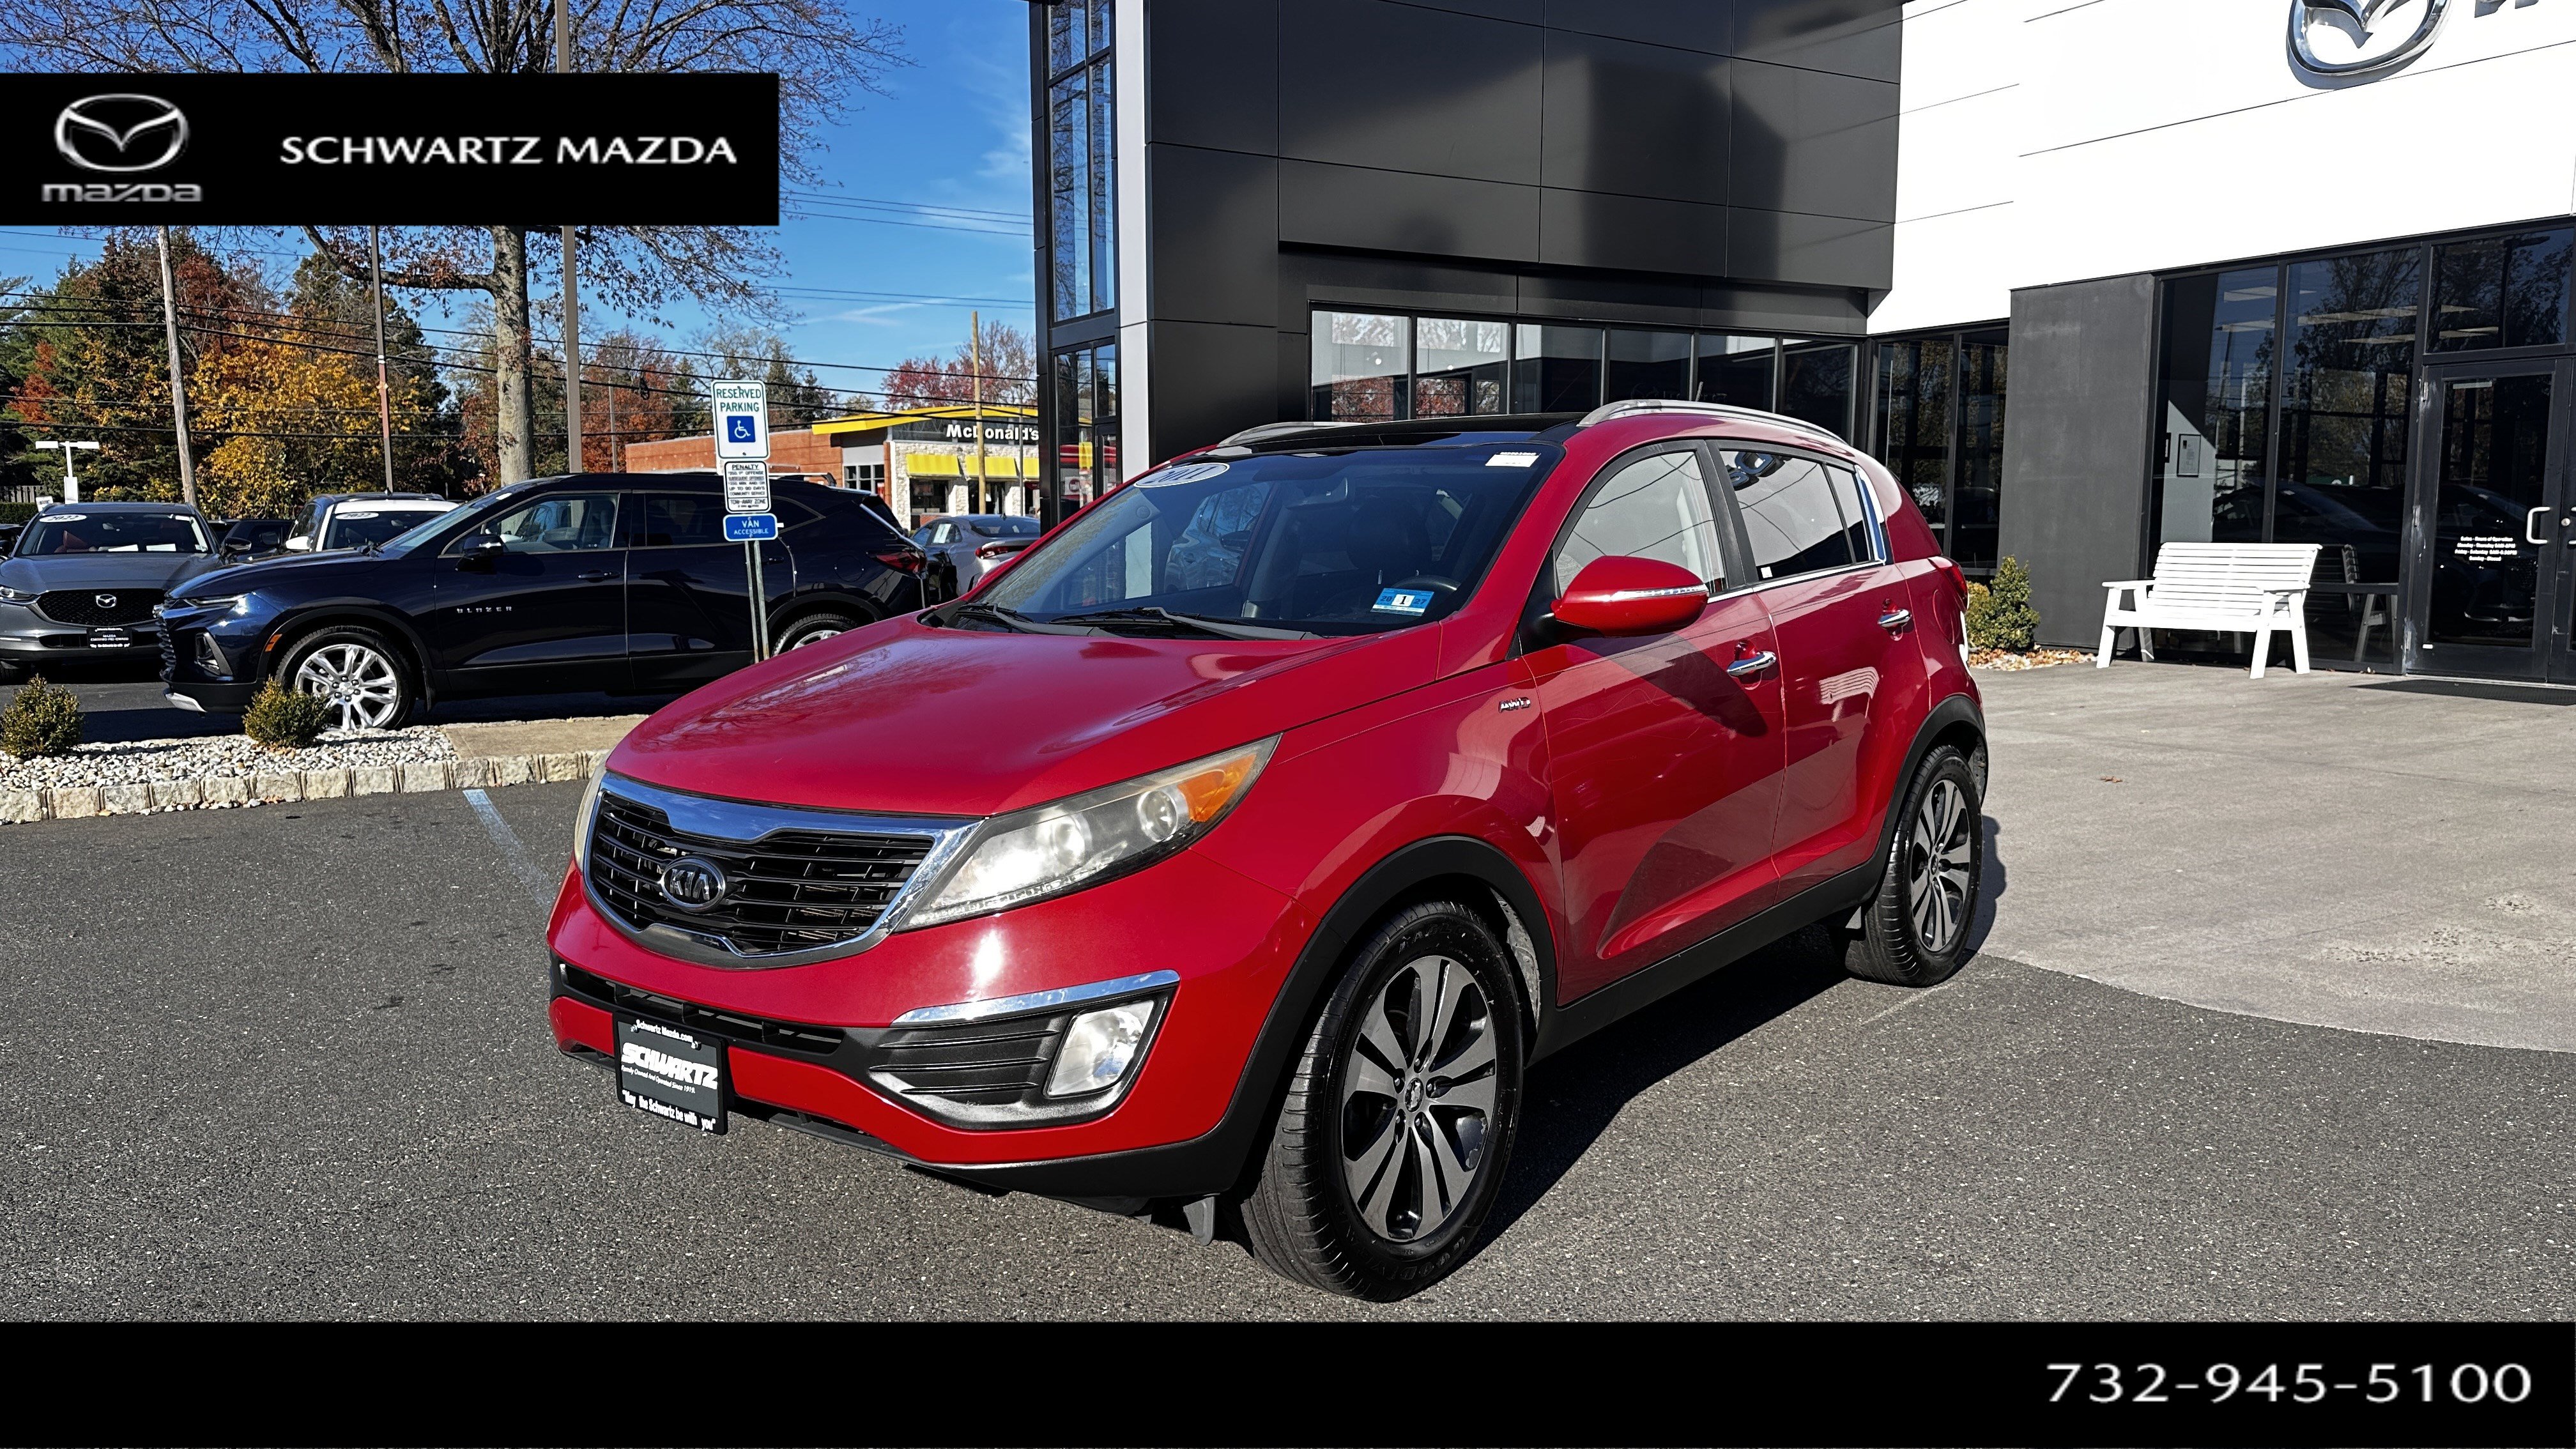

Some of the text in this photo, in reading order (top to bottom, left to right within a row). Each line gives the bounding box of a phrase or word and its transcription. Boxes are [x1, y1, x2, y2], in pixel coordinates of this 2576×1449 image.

[716, 388, 762, 399] RESERVED
[720, 402, 760, 412] PARKING
[742, 520, 760, 528] VAN
[1399, 595, 1407, 604] 1
[670, 868, 710, 900] KIA
[622, 1043, 718, 1090] SCHWARTZ
[648, 1098, 676, 1119] Schwartz
[676, 1107, 684, 1121] be
